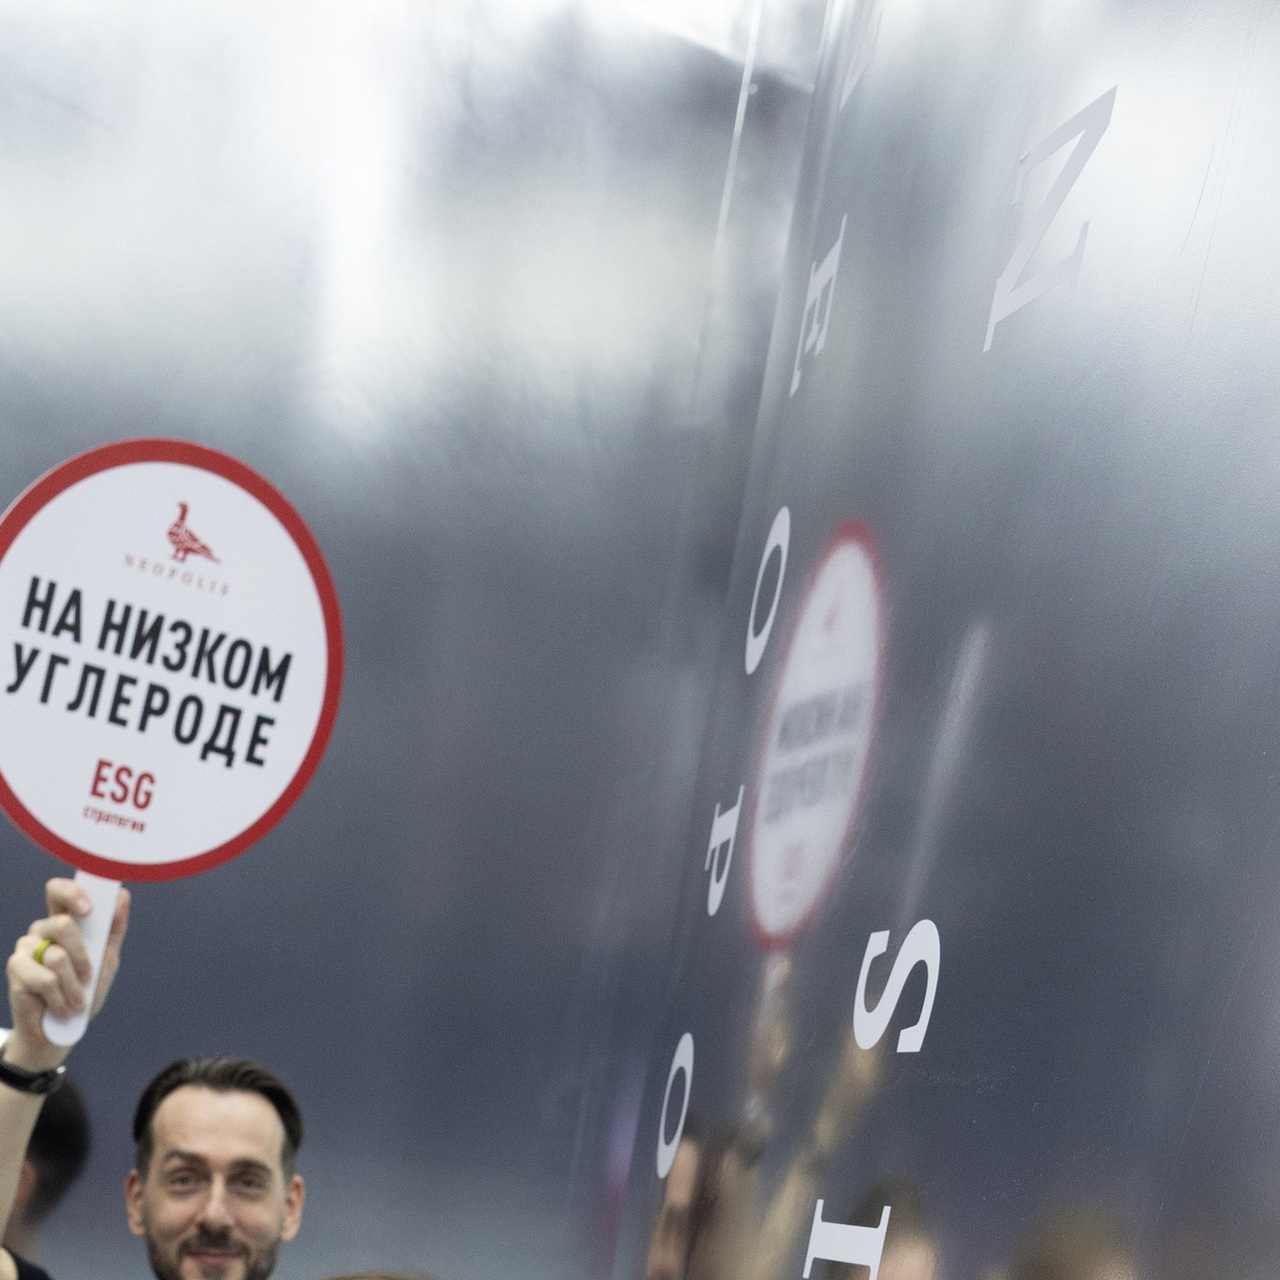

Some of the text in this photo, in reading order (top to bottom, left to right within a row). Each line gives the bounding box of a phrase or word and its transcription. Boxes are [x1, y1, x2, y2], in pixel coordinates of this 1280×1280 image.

[123, 553, 230, 597] NEOPOLIS
[21, 575, 294, 703] НА НИЗКОМ
[6, 642, 276, 768] УГЛЕРОДЕ
[89, 758, 157, 810] ESG
